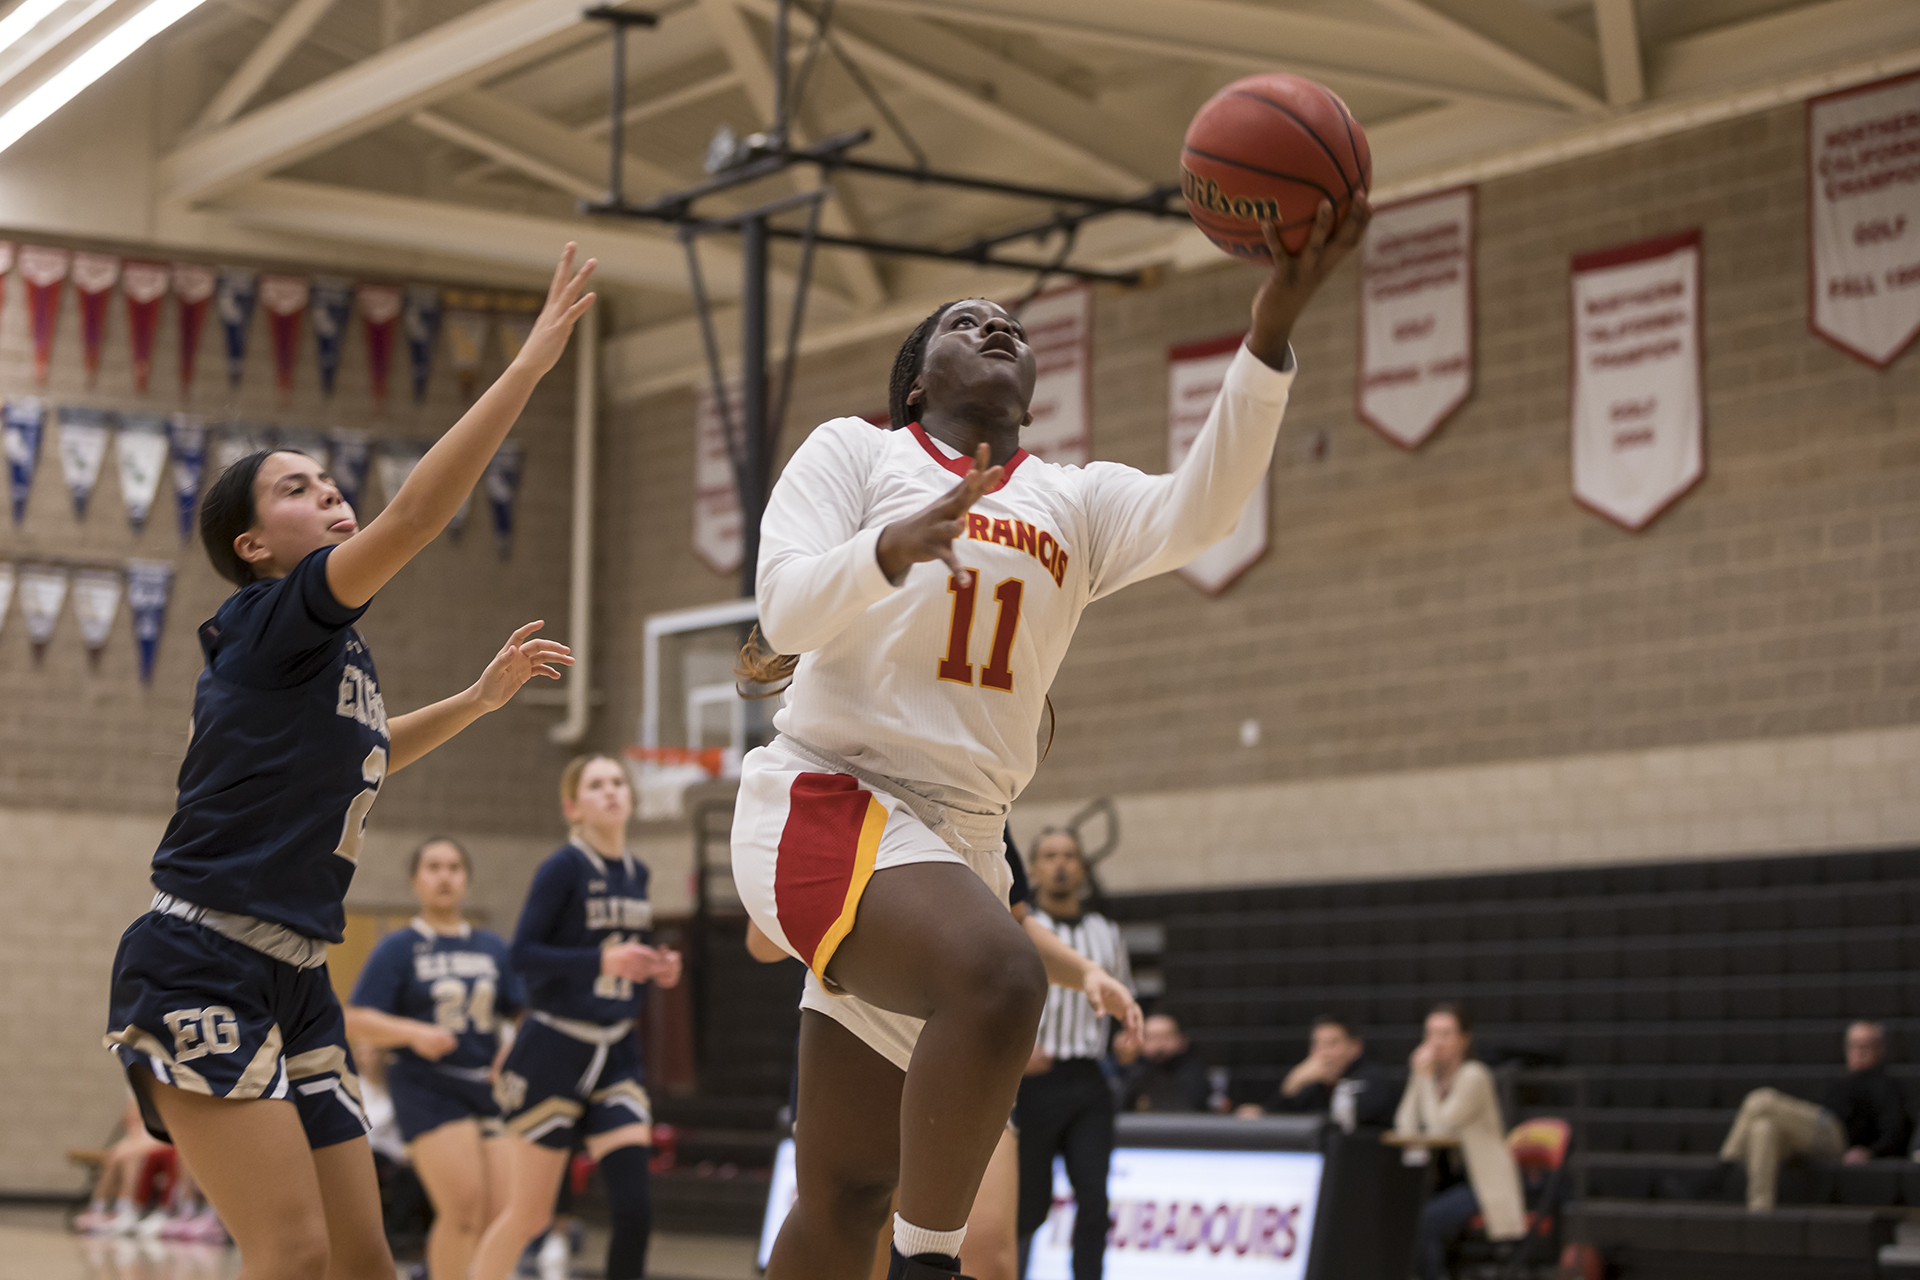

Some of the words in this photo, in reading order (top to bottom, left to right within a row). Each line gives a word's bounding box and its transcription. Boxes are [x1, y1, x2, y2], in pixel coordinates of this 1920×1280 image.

[1825, 113, 1920, 147] NORTHER
[953, 511, 1069, 590] RANCIS
[936, 565, 1025, 694] 11
[163, 1005, 241, 1065] EG
[1050, 1196, 1300, 1260] TUBADOURS
